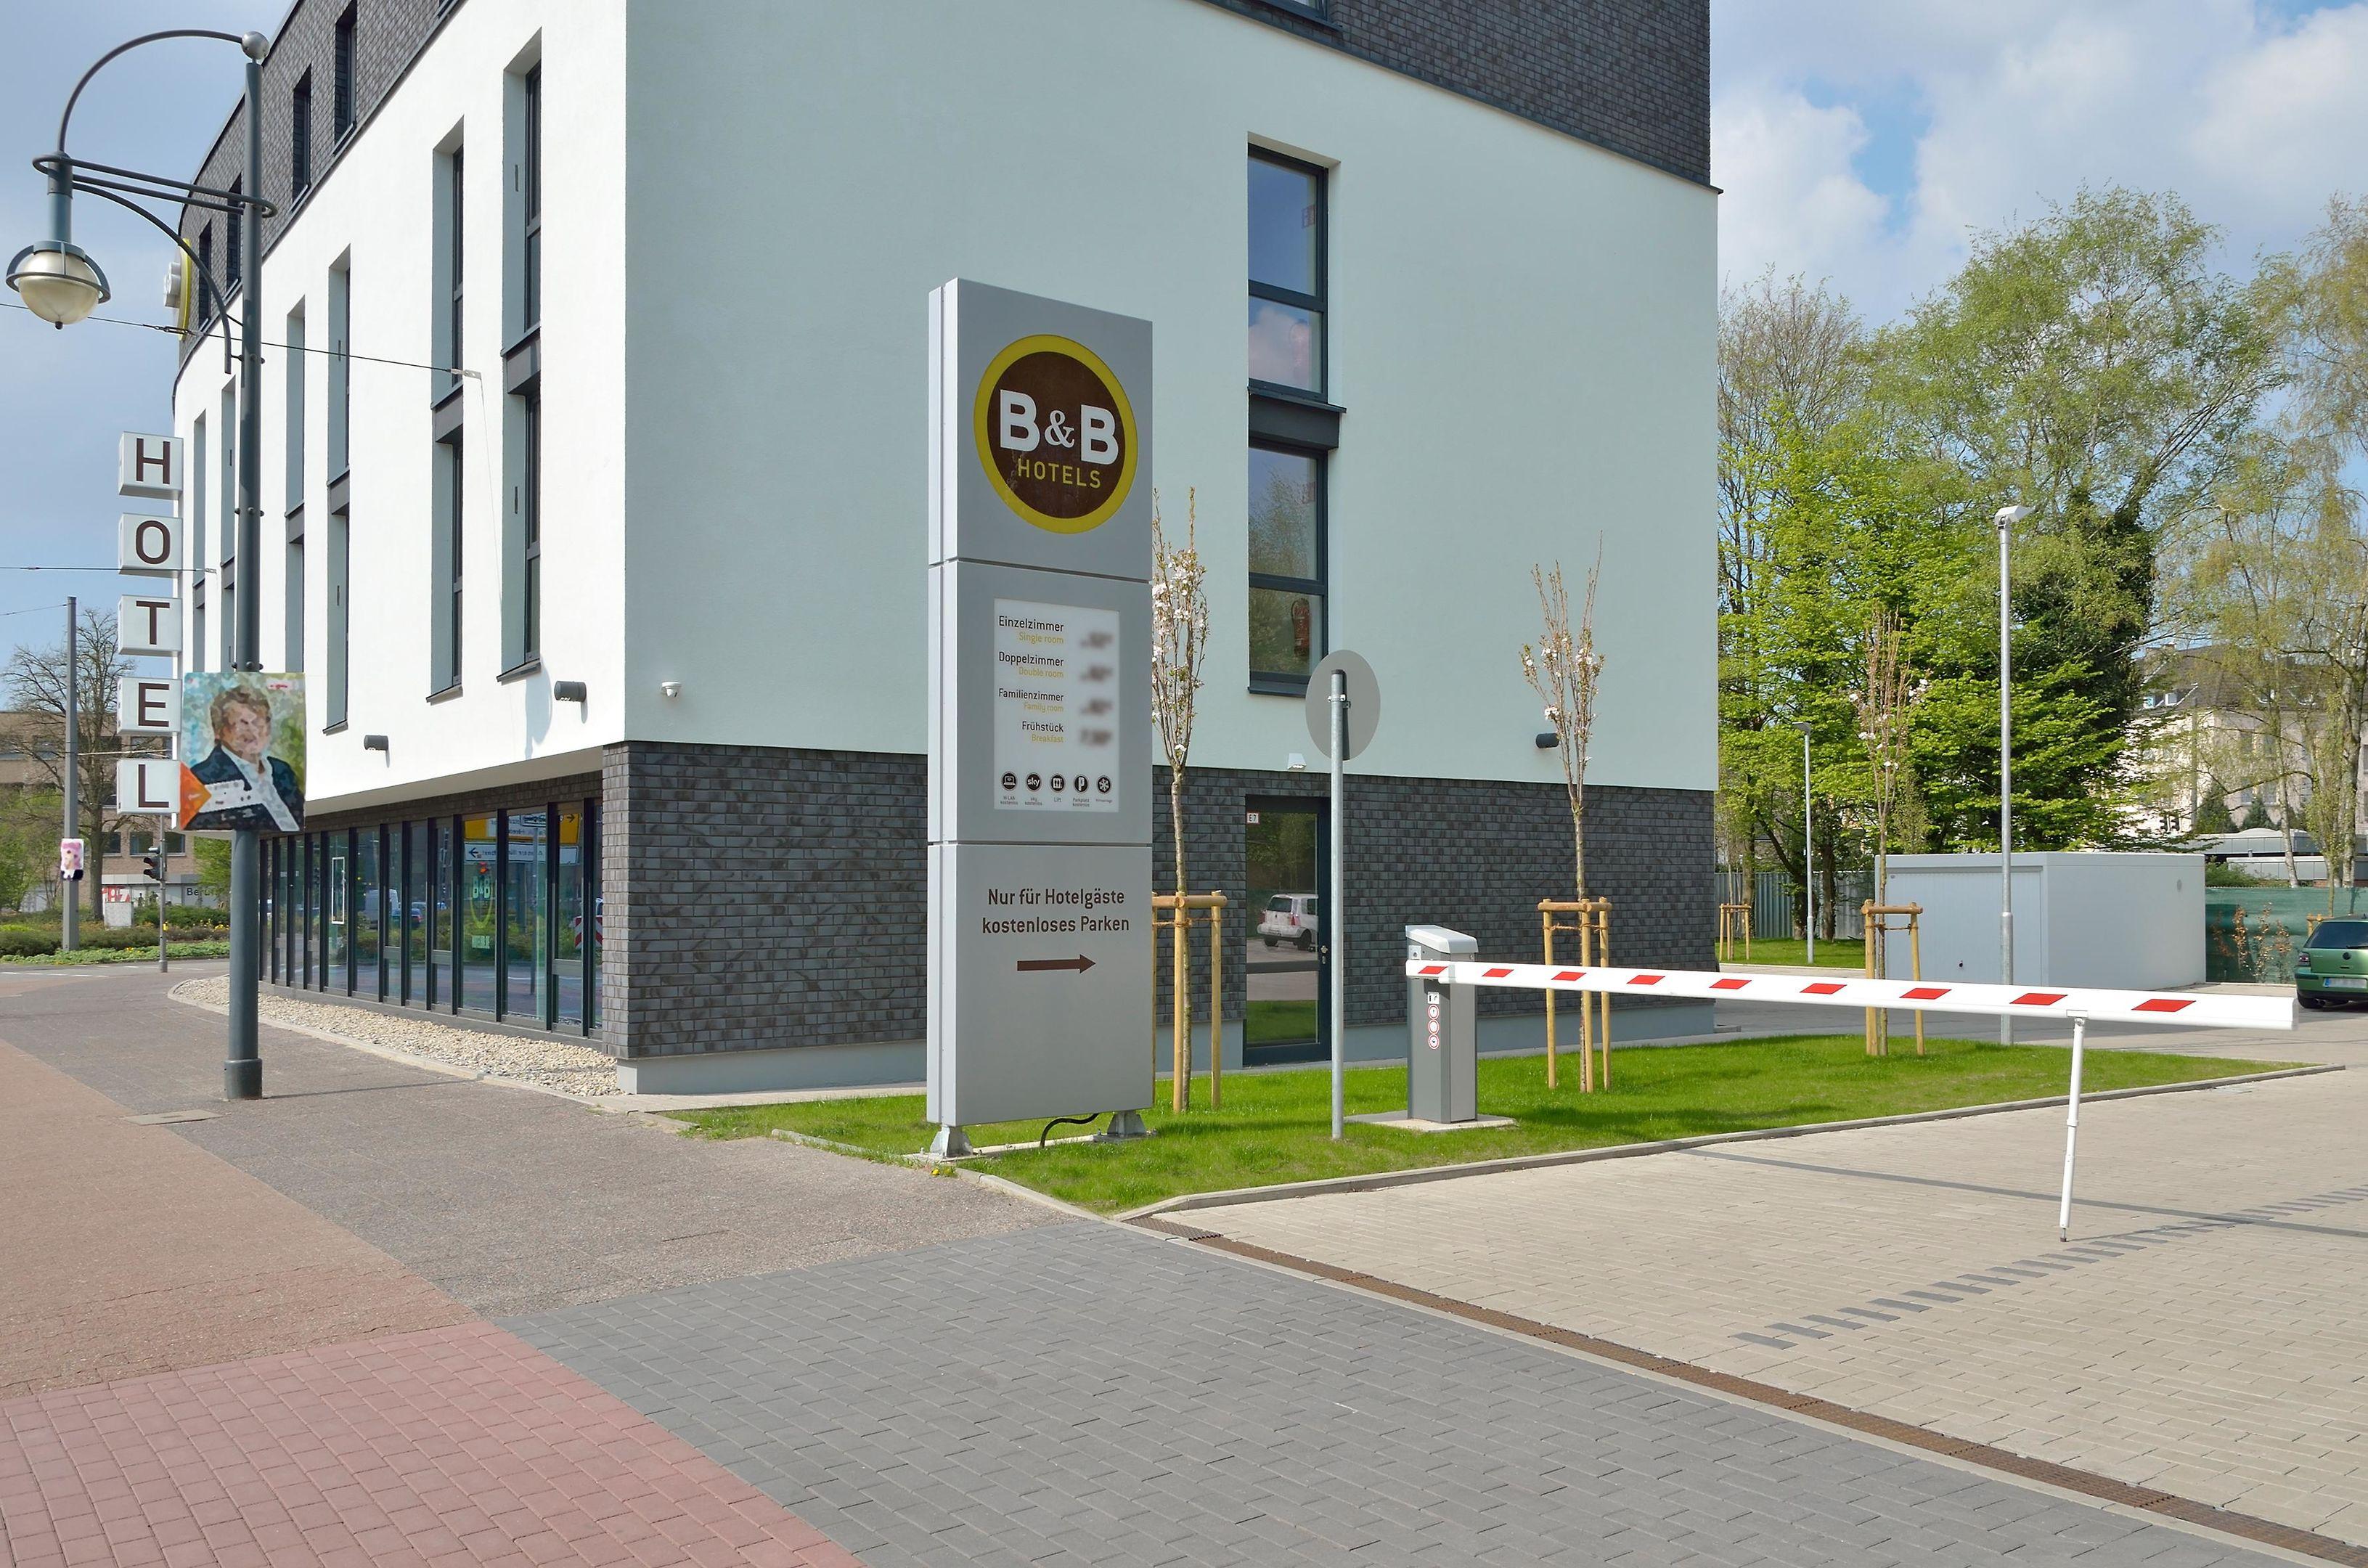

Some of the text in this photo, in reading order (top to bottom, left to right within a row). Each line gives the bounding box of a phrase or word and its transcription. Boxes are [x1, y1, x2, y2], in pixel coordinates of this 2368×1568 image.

[1000, 389, 1119, 465] B&B
[1018, 458, 1101, 489] HOTELS
[136, 438, 170, 808] HOTEL
[999, 616, 1064, 632] Einzelzimmer
[1018, 632, 1042, 645] Single
[999, 651, 1064, 666] Doppelzimmer
[1018, 667, 1064, 678] Double room
[998, 688, 1064, 701] Familienzimmer
[1021, 720, 1064, 732] Frühstück
[1032, 734, 1064, 743] Breakfast
[1027, 777, 1040, 787] sky
[988, 888, 1125, 910] Nur für Hotelgäste
[982, 915, 1130, 934] kostenloses Parken
